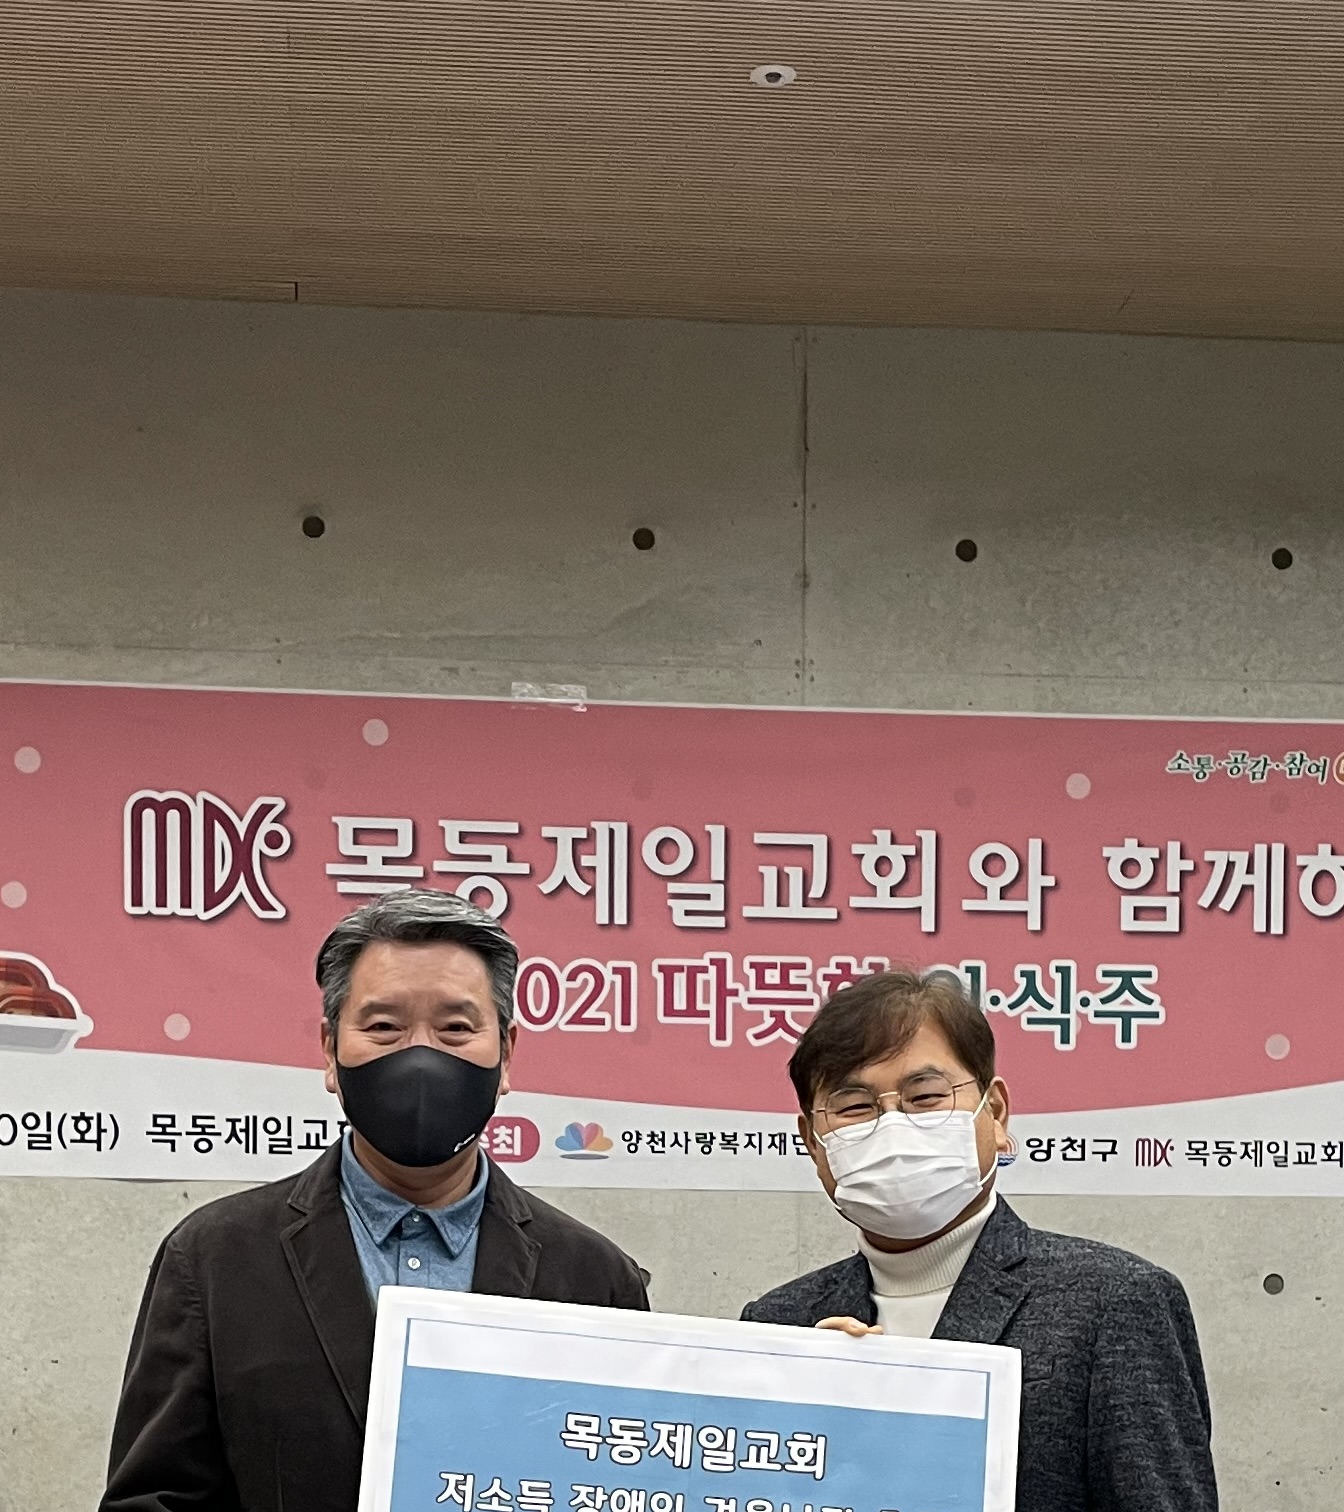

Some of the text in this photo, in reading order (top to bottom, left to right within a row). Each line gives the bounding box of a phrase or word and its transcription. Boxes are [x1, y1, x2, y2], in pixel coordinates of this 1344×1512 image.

[325, 815, 1058, 934] 목동제일교회와
[515, 960, 633, 1029] 021
[145, 1113, 354, 1157] 목동제일교
[1025, 1135, 1120, 1163] 양천구
[559, 1411, 829, 1480] 목동제일교회
